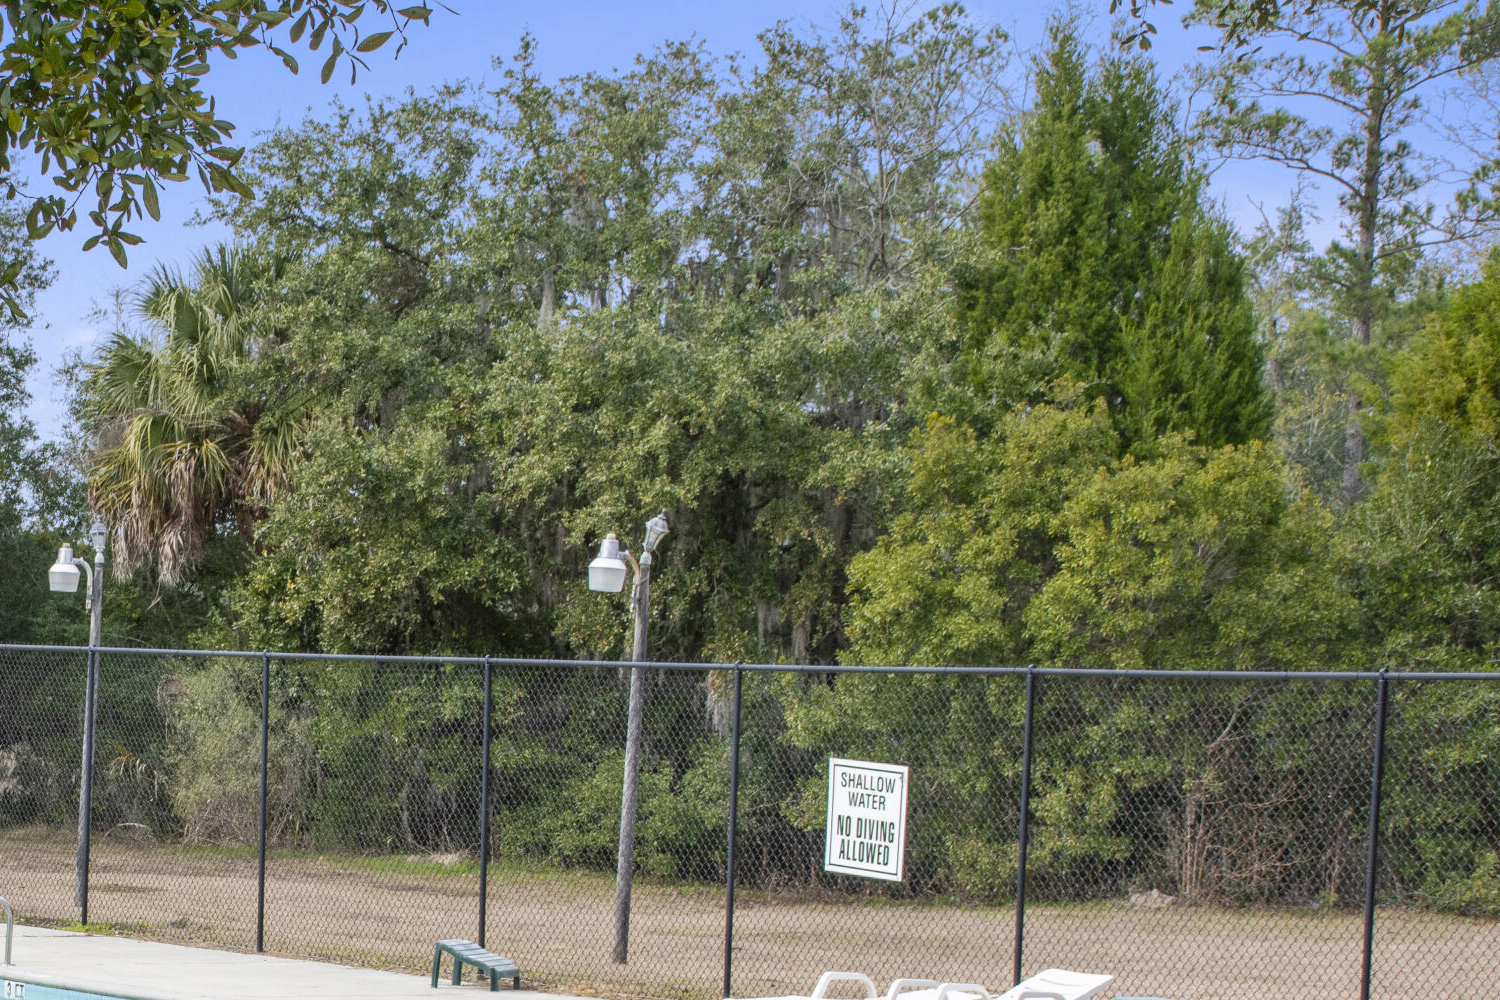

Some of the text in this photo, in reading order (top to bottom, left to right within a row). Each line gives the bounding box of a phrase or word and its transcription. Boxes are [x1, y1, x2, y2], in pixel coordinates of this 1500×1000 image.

[841, 772, 896, 794] SHALLOW
[848, 791, 886, 811] WATER
[837, 815, 895, 844] NO DIVING
[839, 839, 890, 866] ALLOWED
